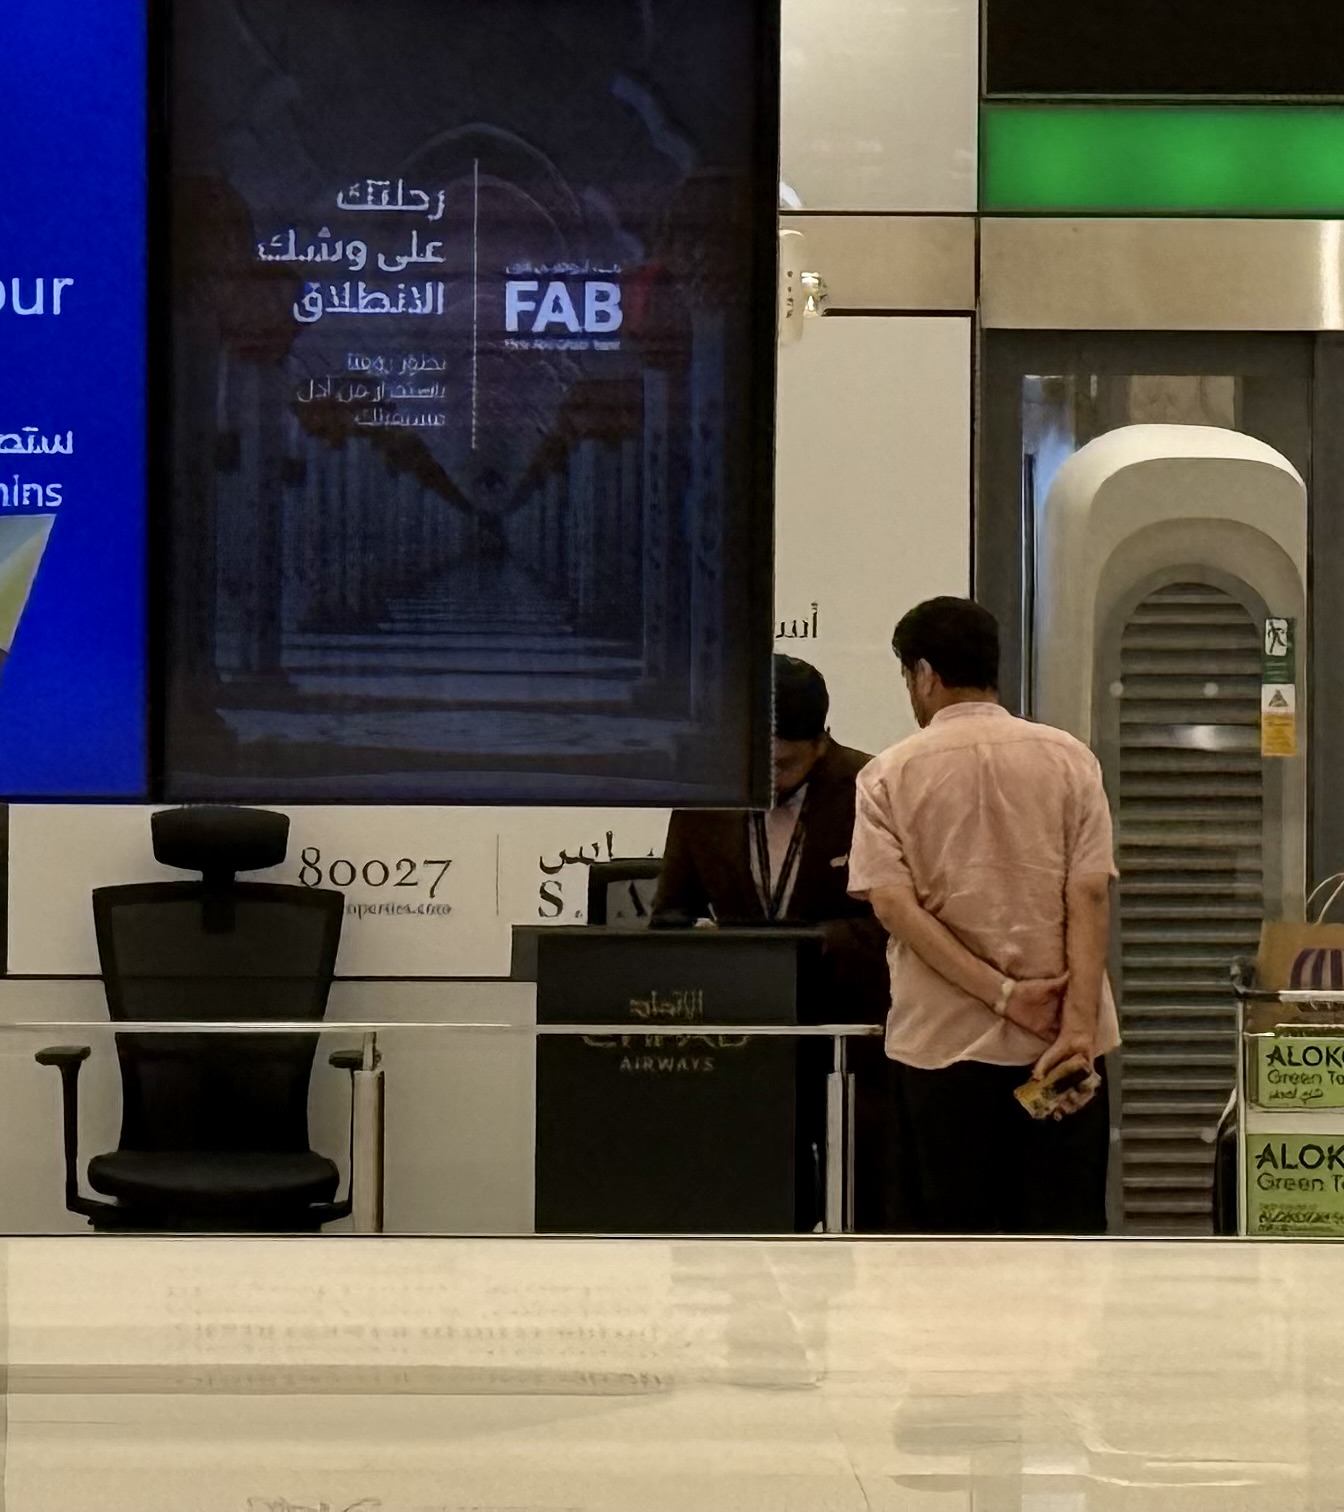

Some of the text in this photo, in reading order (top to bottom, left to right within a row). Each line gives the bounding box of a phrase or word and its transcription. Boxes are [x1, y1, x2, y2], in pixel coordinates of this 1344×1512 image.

[336, 177, 446, 221] رحلتك
[256, 225, 447, 272] على وشك
[292, 280, 446, 323] الانطلاق
[505, 280, 624, 333] FAB
[297, 845, 454, 899] 80027
[619, 1054, 716, 1073] AIRWAYS
[1266, 1068, 1323, 1087] Green
[1256, 1172, 1326, 1194] Green
